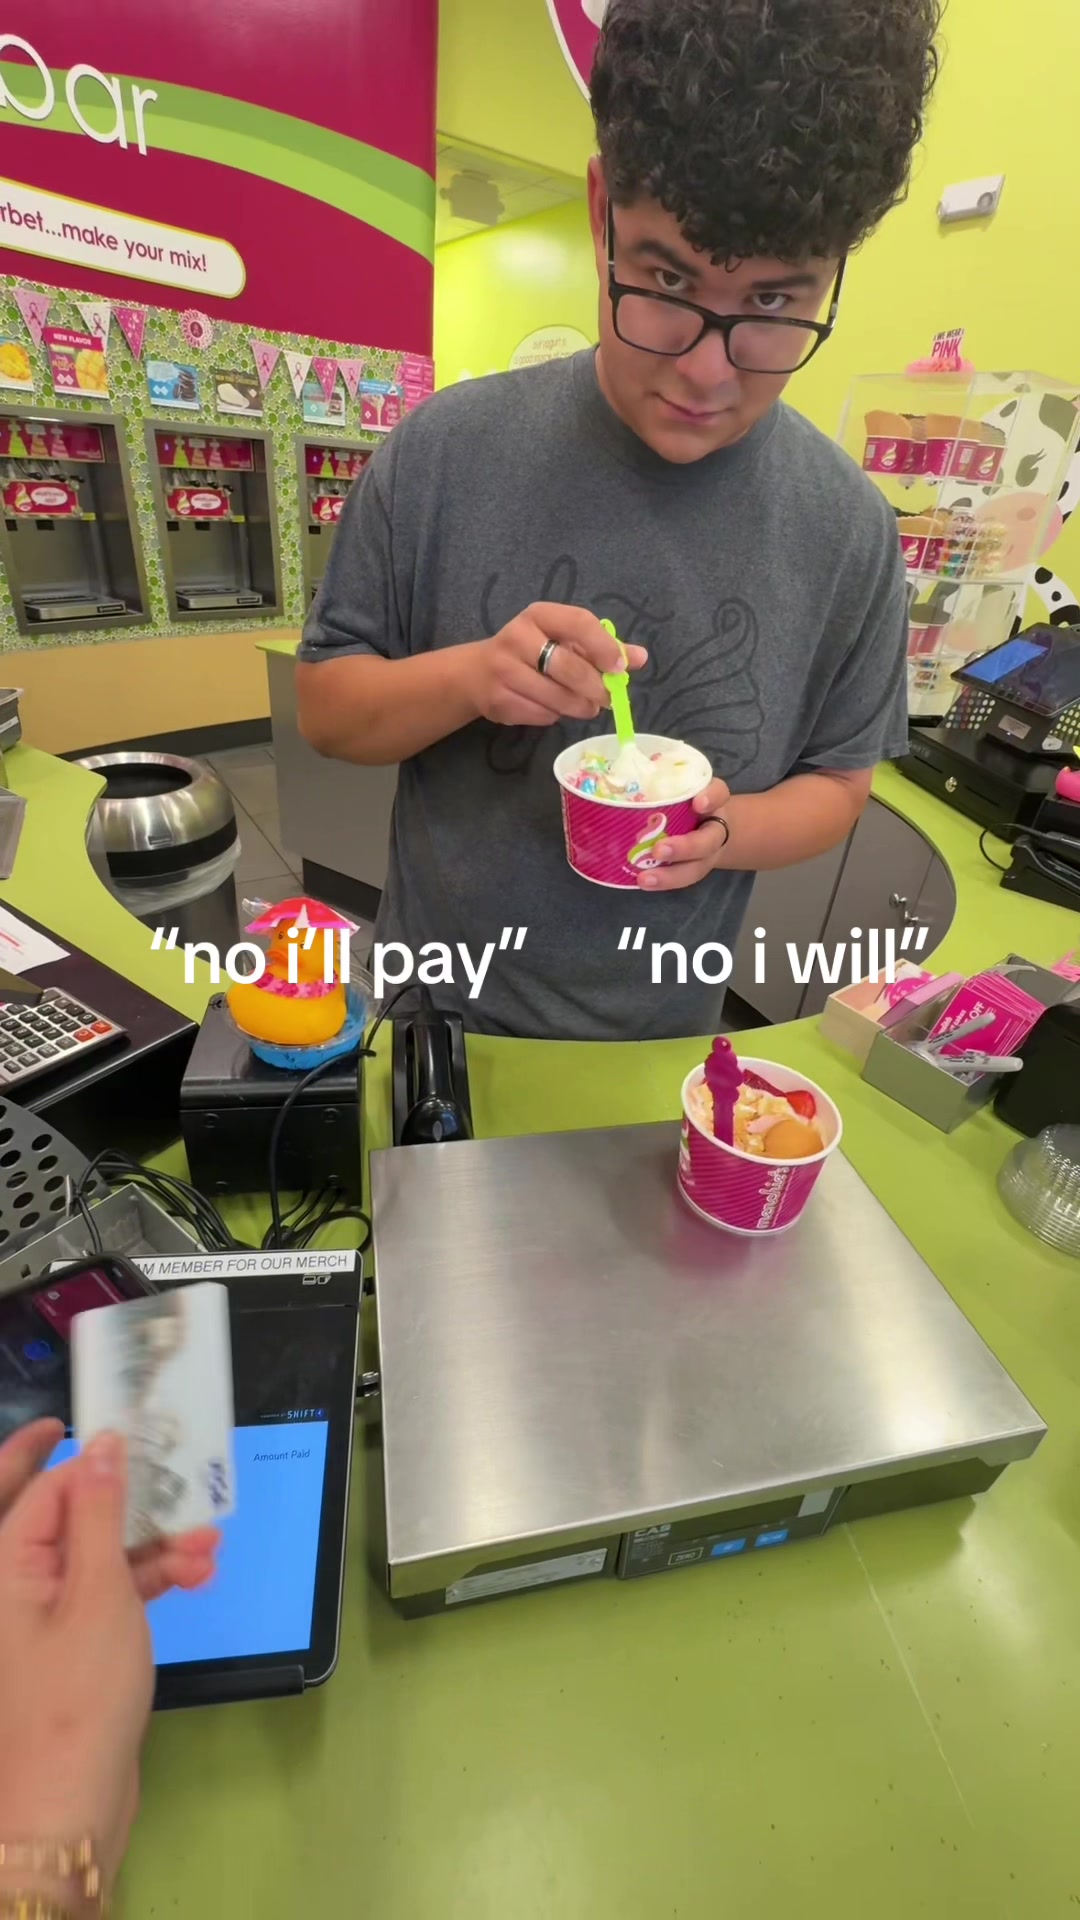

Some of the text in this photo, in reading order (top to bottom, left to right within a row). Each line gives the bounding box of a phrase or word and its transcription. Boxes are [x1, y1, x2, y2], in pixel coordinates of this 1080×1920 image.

[124, 239, 164, 261] your
[169, 247, 207, 273] mix!
[53, 333, 92, 346] NEW FLAVOR
[931, 337, 962, 358] PINK
[969, 1001, 985, 1020] OFF
[158, 1259, 223, 1274] MEMBER
[227, 1258, 256, 1272] FOR
[260, 1256, 292, 1271] OUR
[296, 1255, 348, 1269] MERCH
[253, 1449, 311, 1462] Amount Paid
[635, 1524, 670, 1538] CAS
[675, 1551, 698, 1562] ZERO
